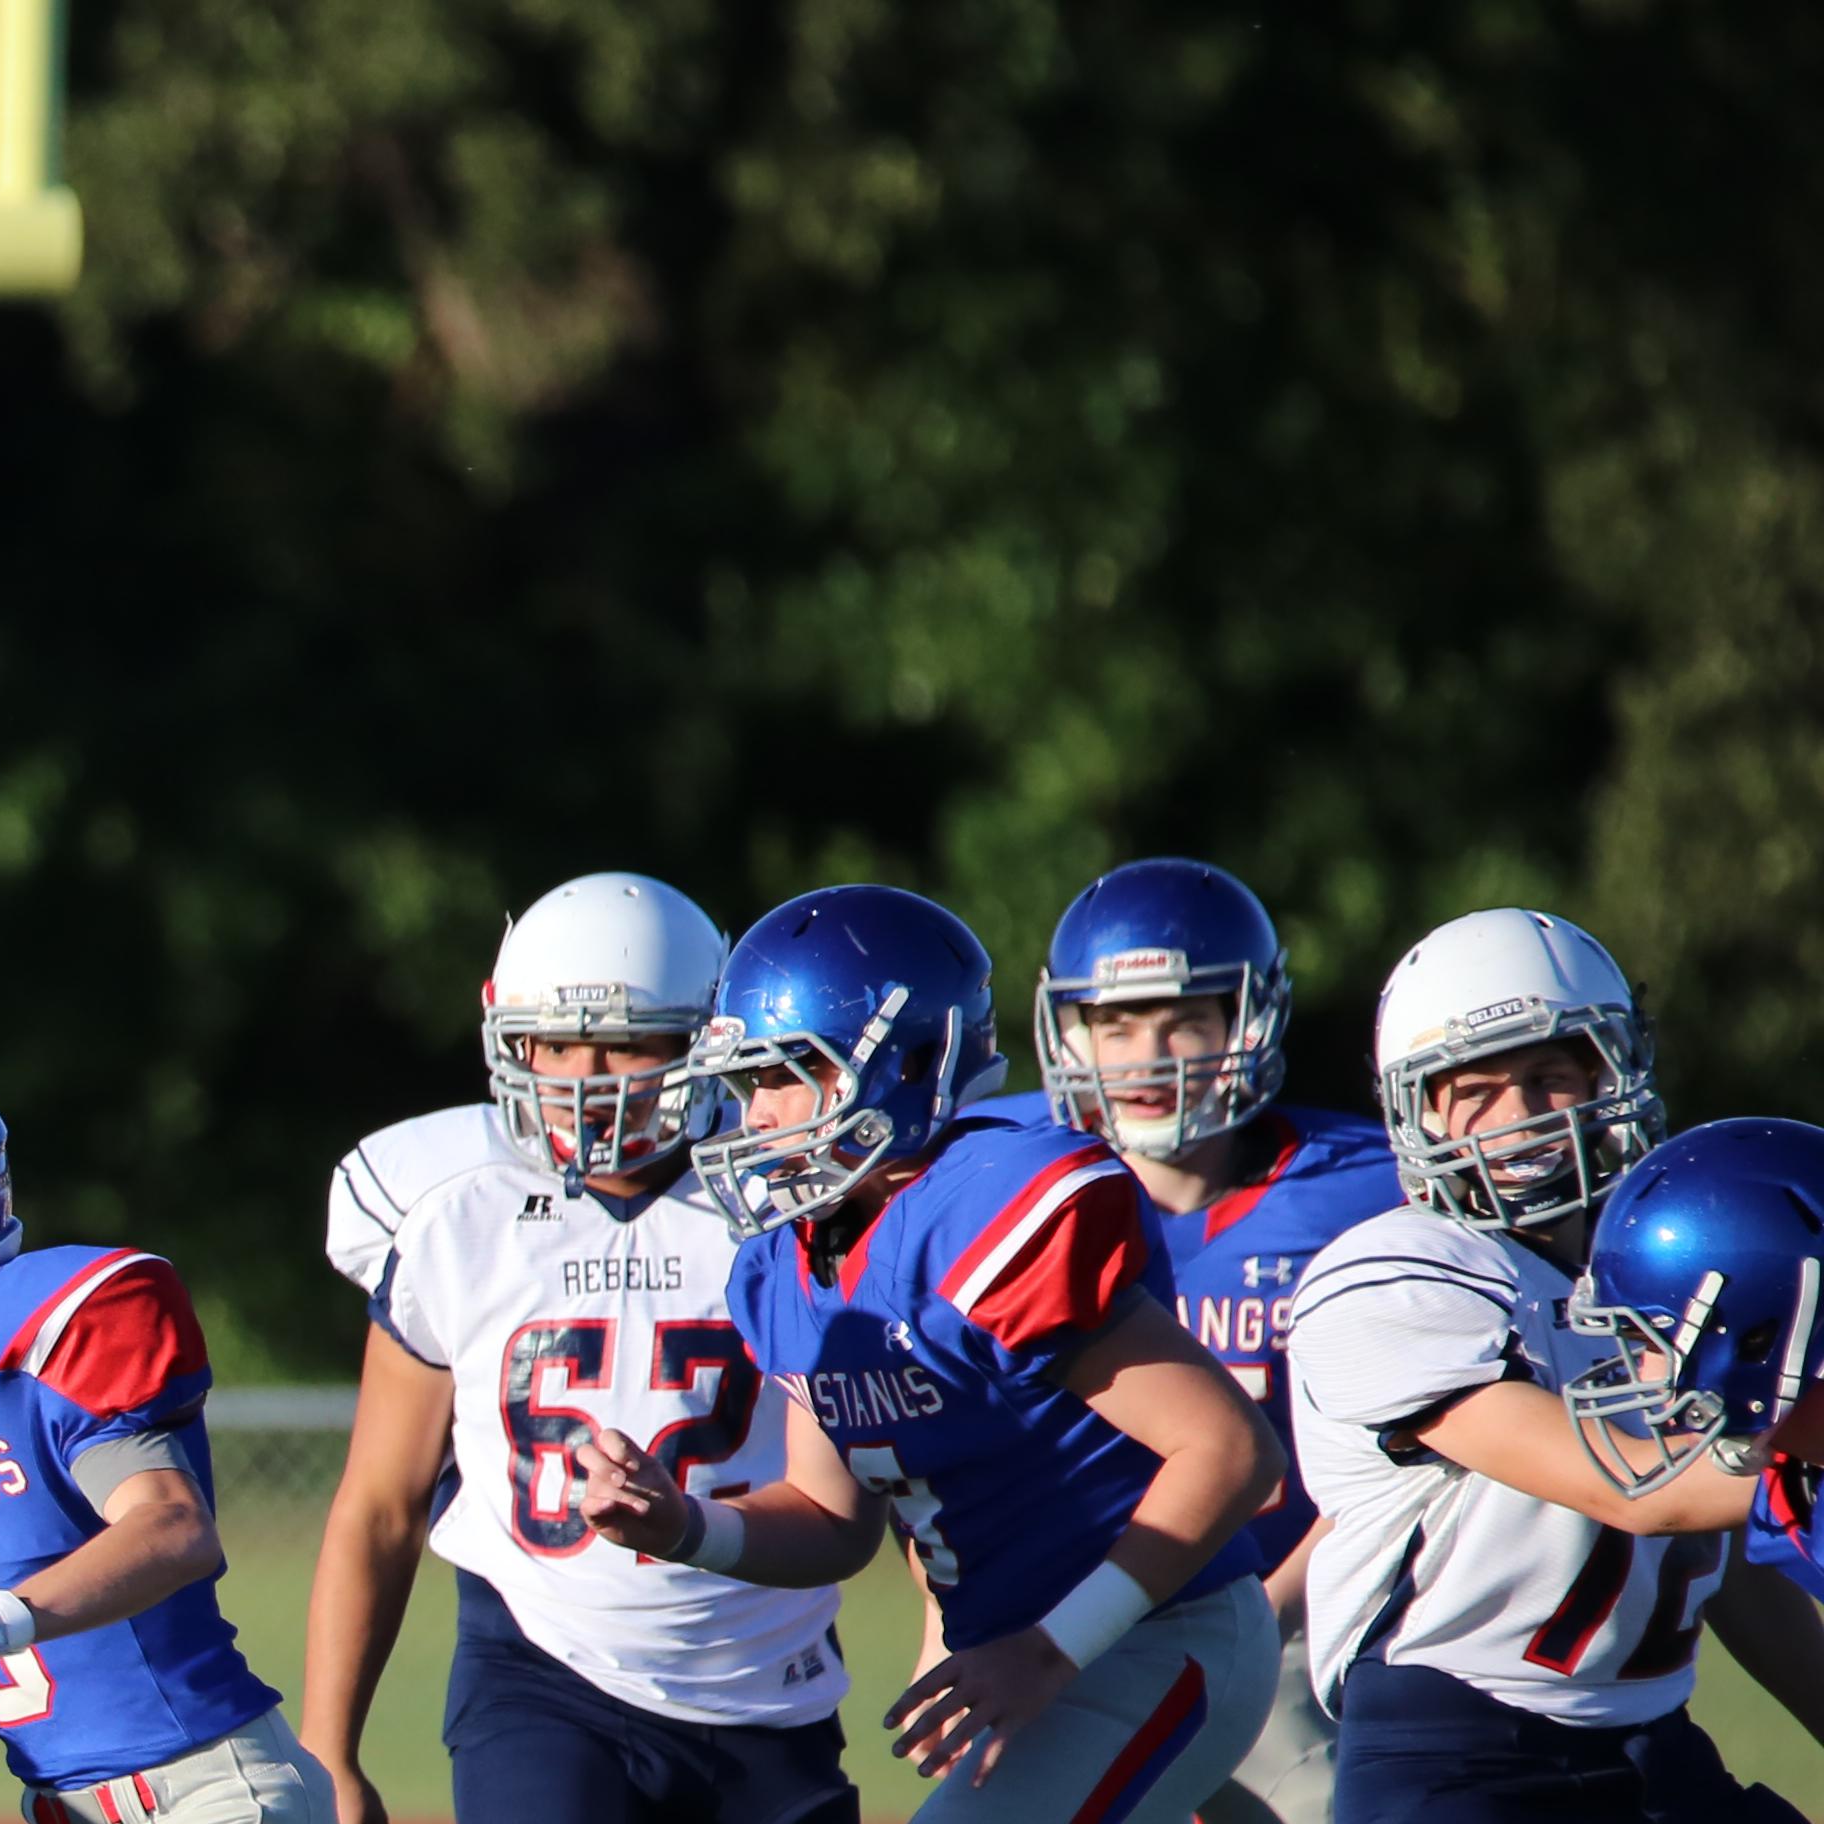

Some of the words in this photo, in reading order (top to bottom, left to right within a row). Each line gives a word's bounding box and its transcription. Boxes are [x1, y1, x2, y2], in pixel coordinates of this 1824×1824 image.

[1466, 1000, 1522, 1026] BELIEVE
[563, 1256, 682, 1296] REBELS
[499, 1318, 764, 1567] 62
